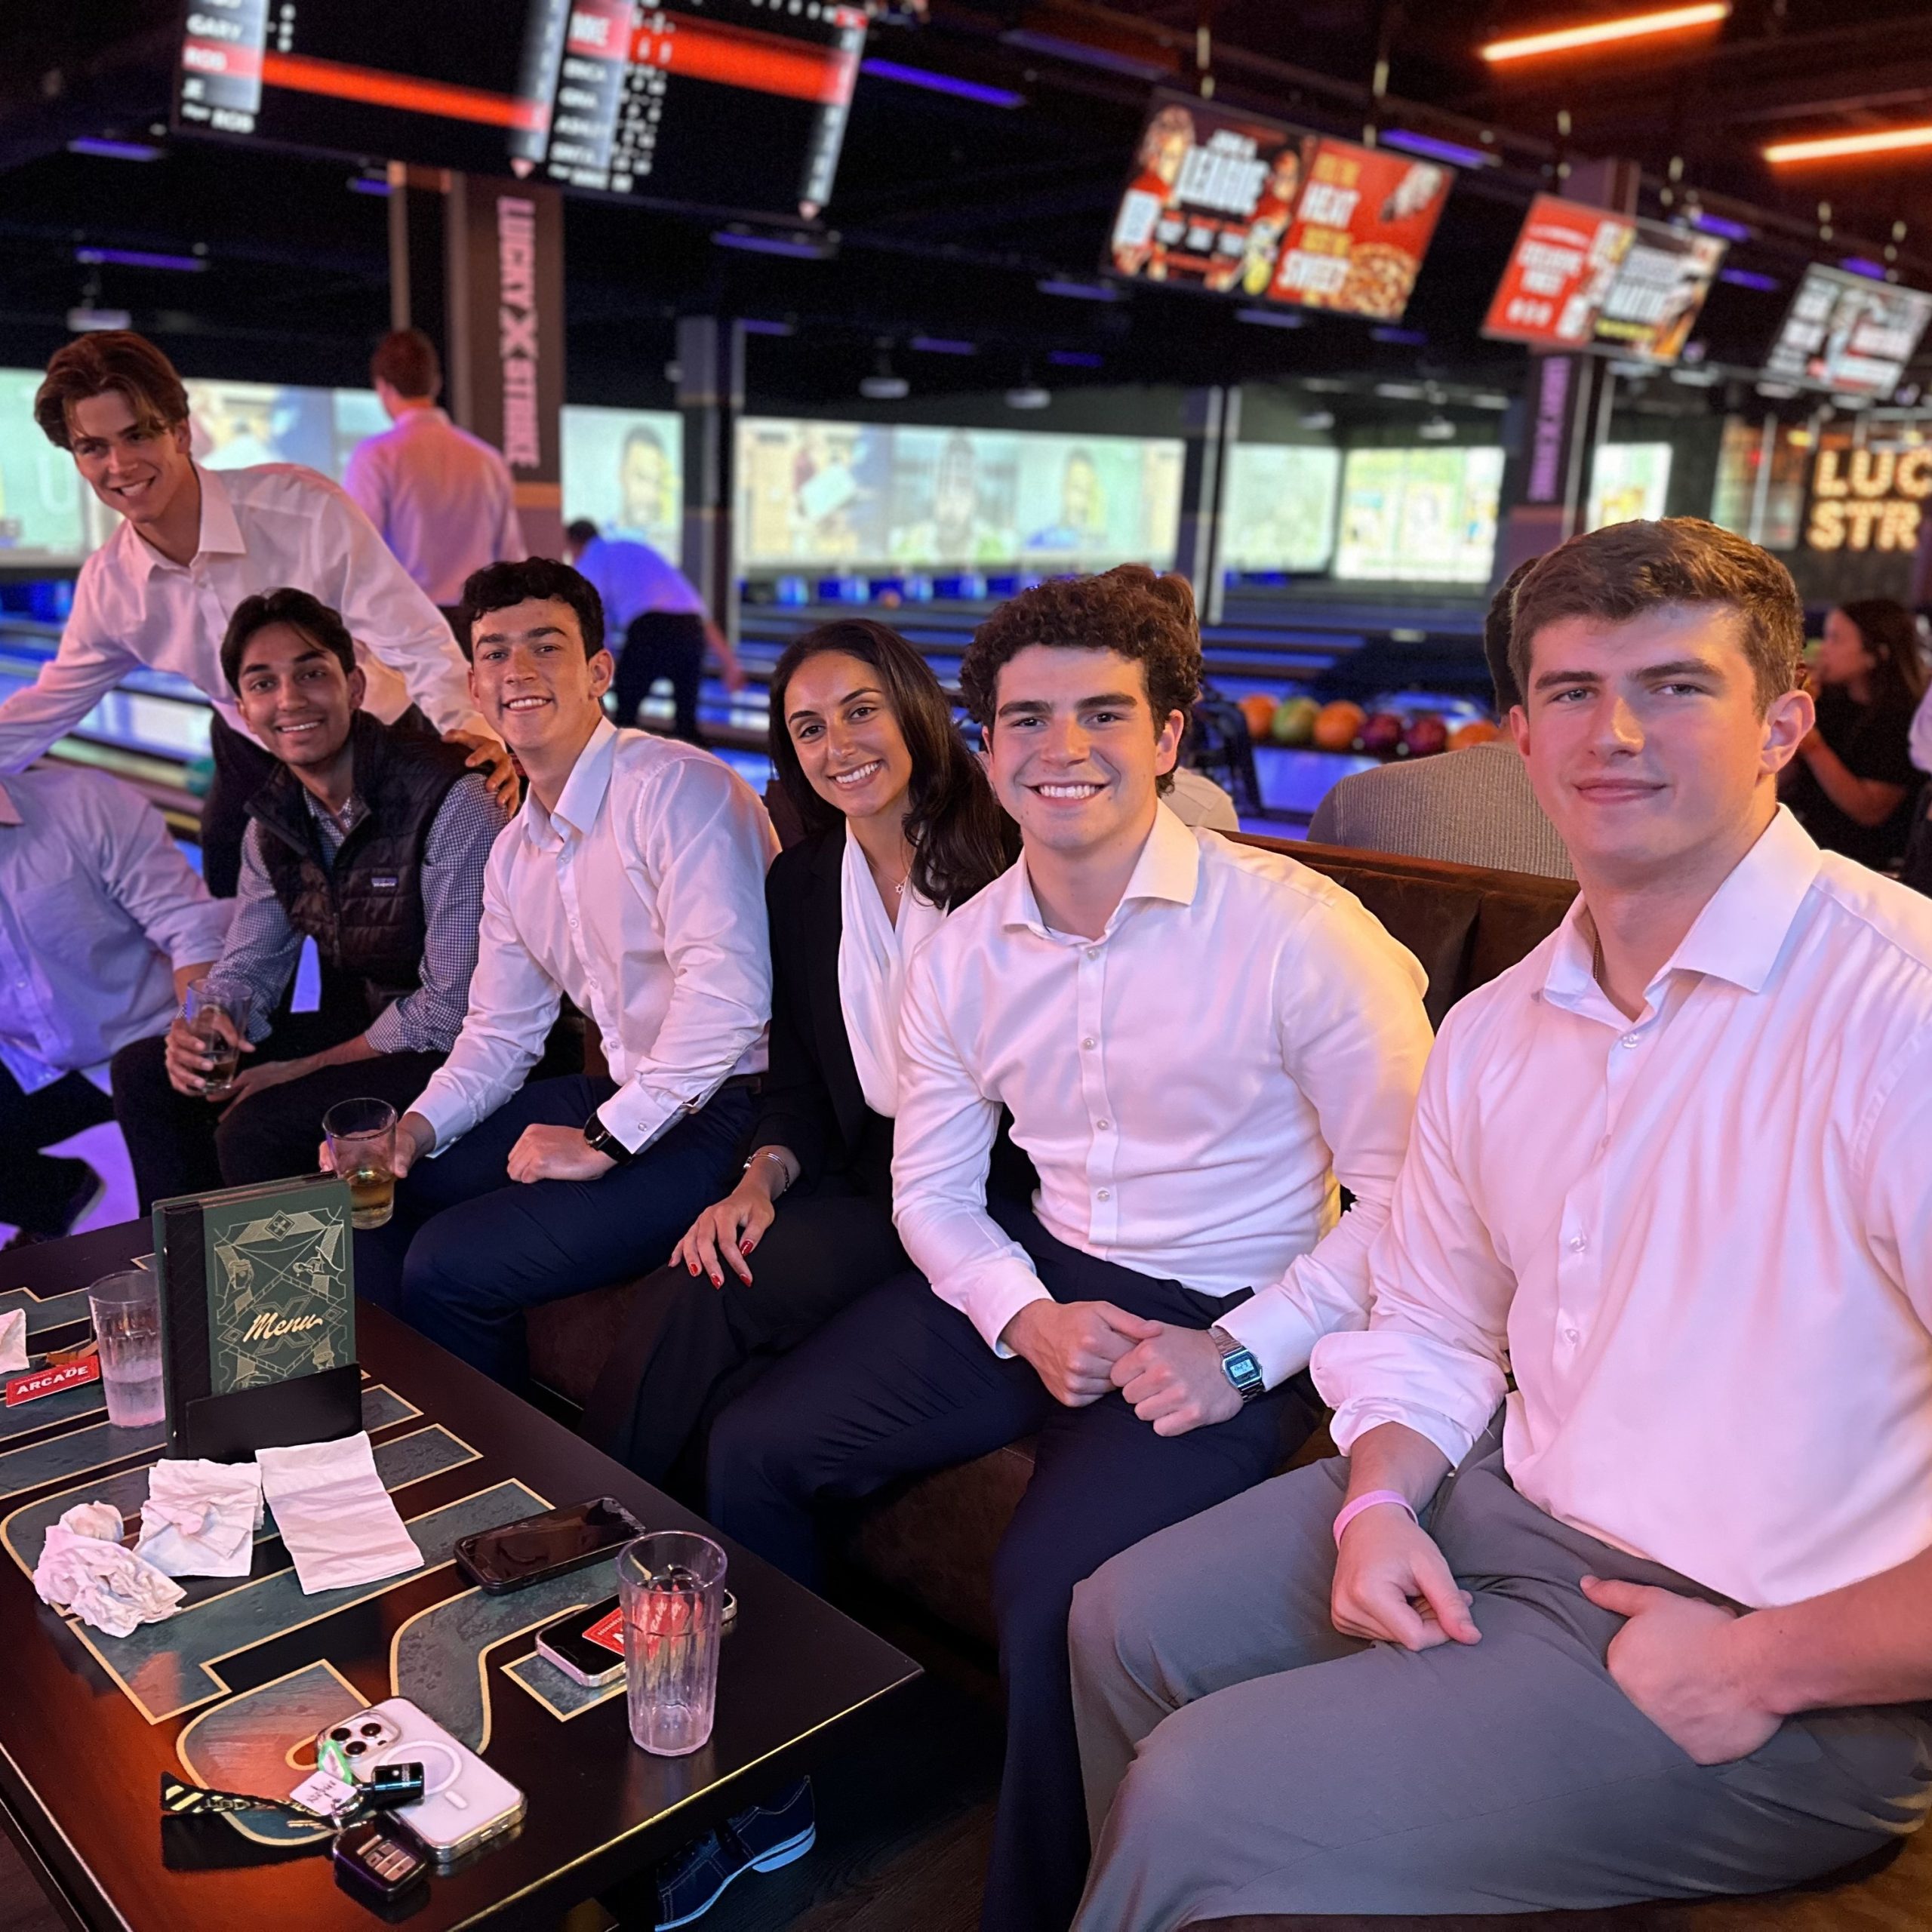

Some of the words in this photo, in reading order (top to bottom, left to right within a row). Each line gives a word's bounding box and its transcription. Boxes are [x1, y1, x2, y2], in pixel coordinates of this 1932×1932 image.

[497, 196, 536, 306] LUCKY
[242, 1312, 325, 1343] Menu
[15, 1364, 91, 1397] ARCADE
